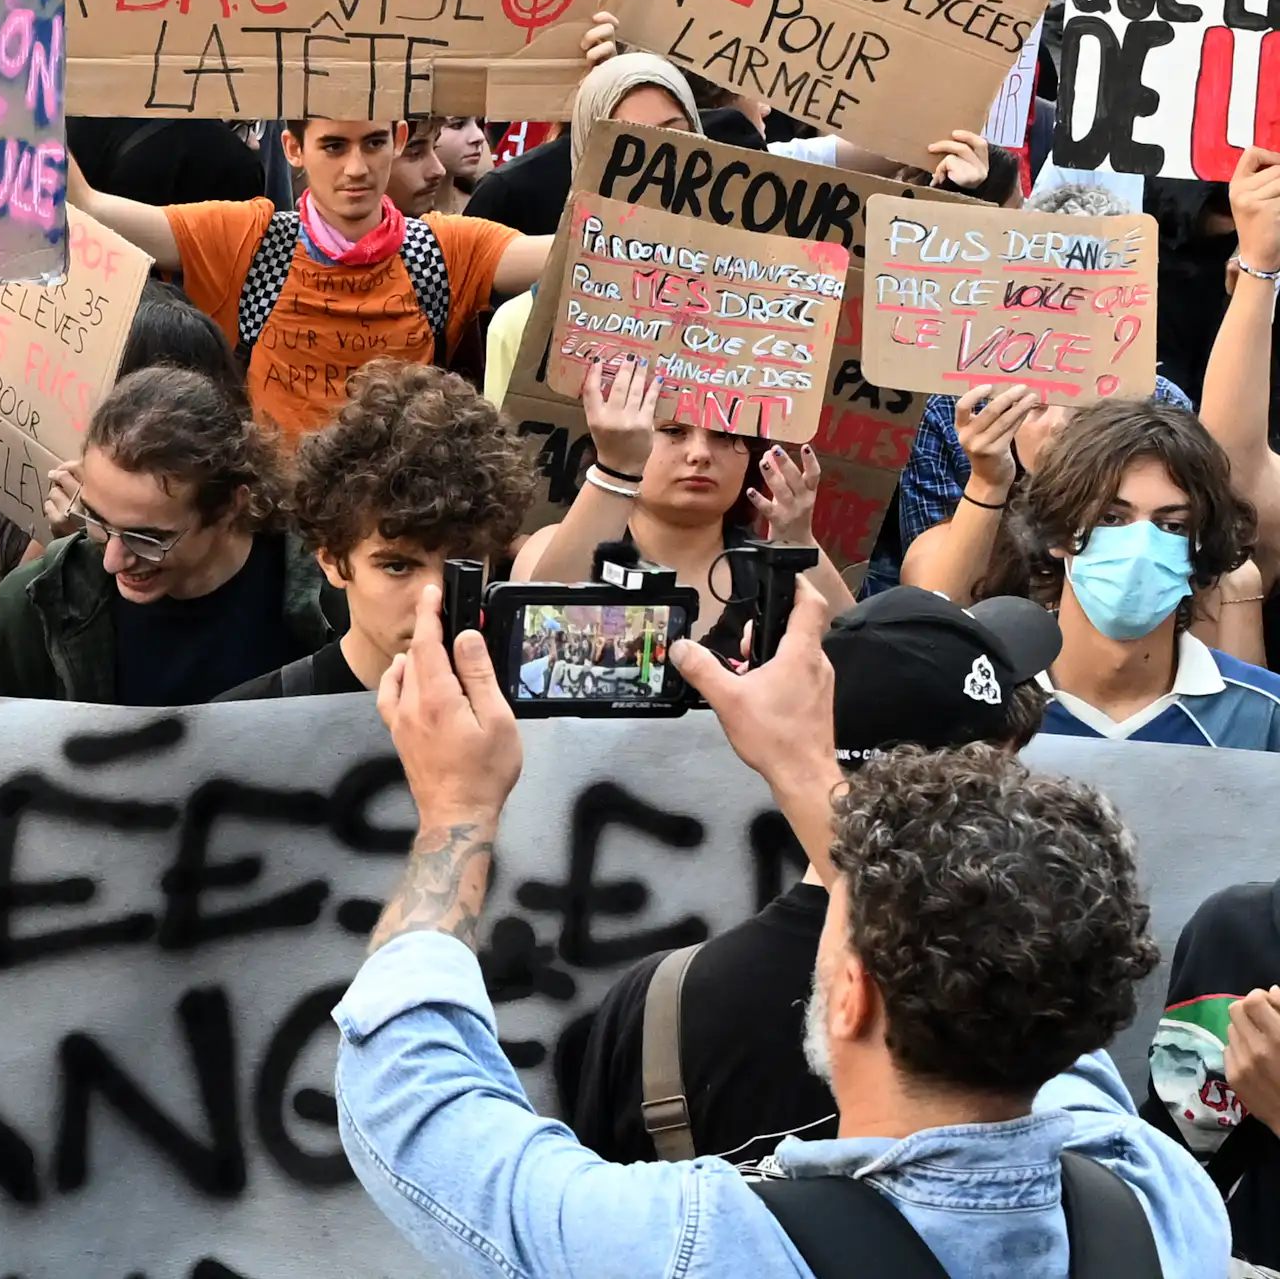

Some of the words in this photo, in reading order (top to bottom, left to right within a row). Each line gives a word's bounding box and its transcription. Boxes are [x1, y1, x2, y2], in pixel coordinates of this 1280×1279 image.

[143, 20, 245, 115] LA
[241, 10, 450, 121] TÊTE
[667, 16, 862, 131] L'ARMÉE
[1052, 14, 1176, 176] DE
[598, 132, 867, 258] PARCOUR
[581, 216, 675, 265] PARDON
[677, 247, 710, 275] DE
[713, 254, 845, 300] MANIFESTER
[79, 287, 110, 327] 35
[571, 264, 624, 302] POUR
[631, 268, 711, 314] MES
[875, 272, 943, 312] PAR
[1090, 283, 1152, 319] QUE
[261, 324, 319, 350] OUR
[336, 330, 389, 352] VOUS
[566, 300, 672, 342] PENDANT
[682, 324, 746, 356] QUE
[890, 315, 947, 350] LE
[24, 342, 92, 432] FLICS
[655, 352, 757, 388] MANGENT
[760, 368, 813, 390] DES
